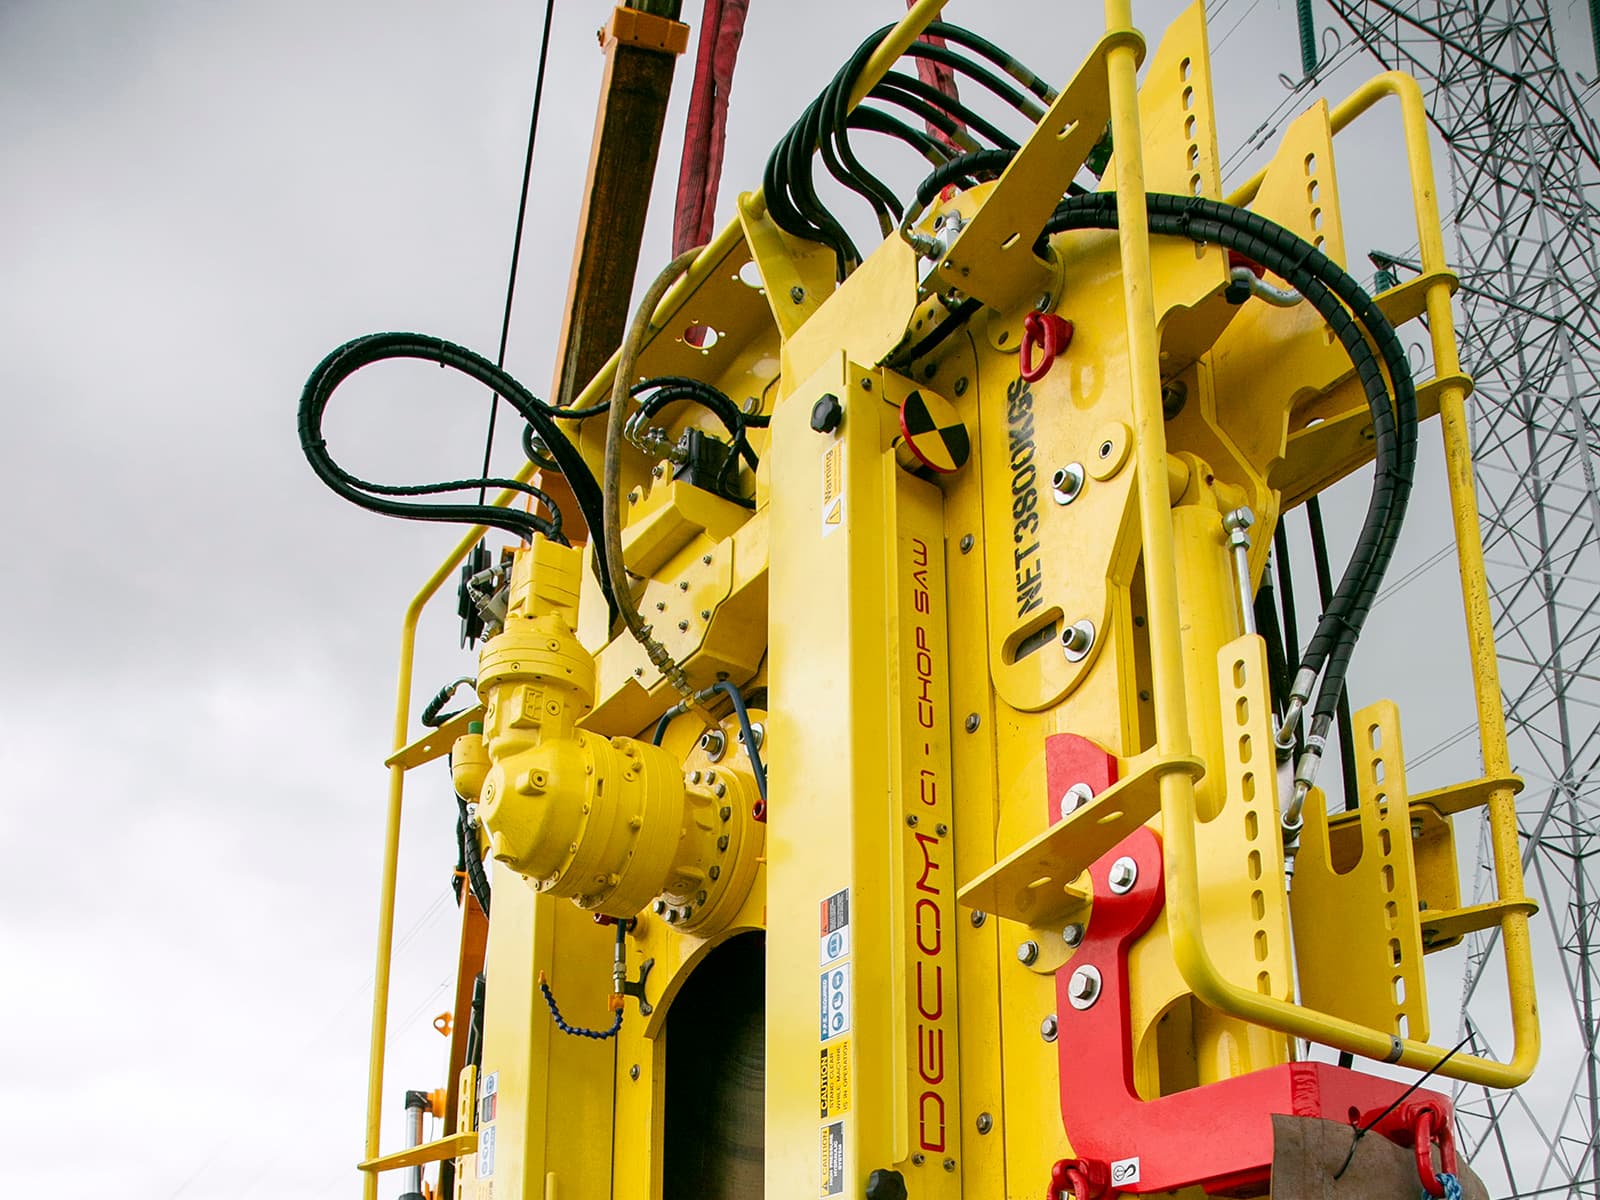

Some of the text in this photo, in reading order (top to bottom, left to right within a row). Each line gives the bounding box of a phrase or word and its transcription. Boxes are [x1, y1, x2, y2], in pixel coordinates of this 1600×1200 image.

[824, 450, 833, 504] Warning
[913, 538, 930, 615] SAW
[916, 626, 934, 729] CHOP
[920, 769, 936, 806] C1
[915, 832, 945, 1153] DECOM
